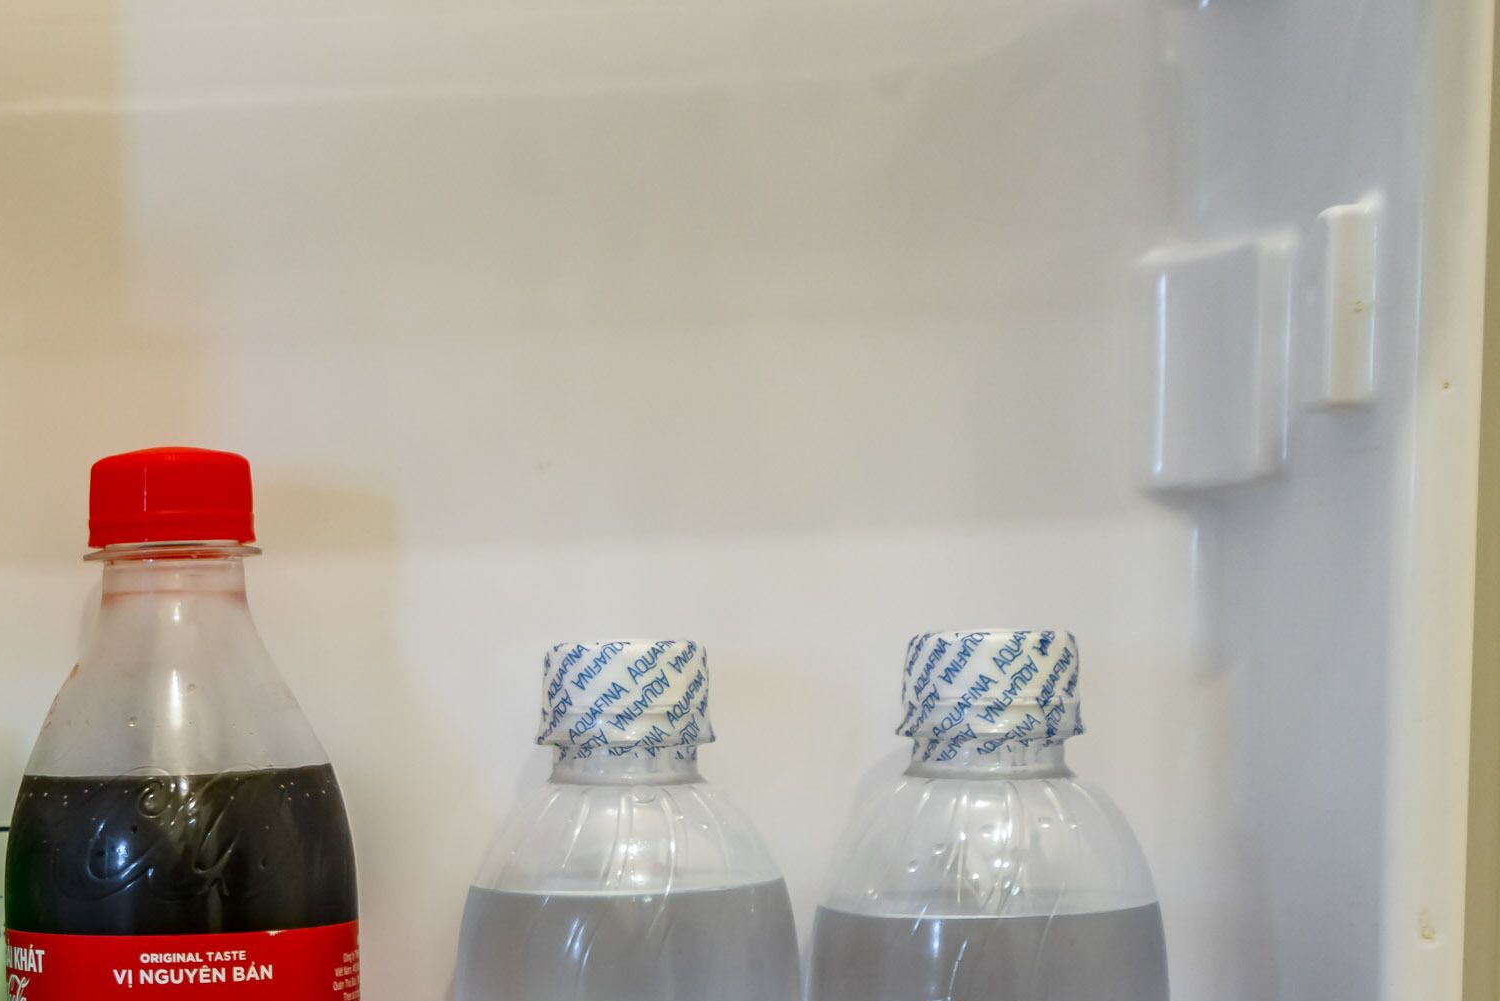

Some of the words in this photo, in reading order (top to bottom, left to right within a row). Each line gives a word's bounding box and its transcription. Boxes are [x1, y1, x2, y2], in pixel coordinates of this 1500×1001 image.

[567, 681, 630, 745] AQUAFINA
[606, 668, 670, 731] AQUAFINA
[933, 674, 998, 737] AQUAFINA
[976, 655, 1038, 724] AQUAFINA
[14, 944, 45, 973] KHÁT
[113, 969, 133, 988] VỊ
[139, 965, 226, 985] NGUYÊN
[233, 962, 273, 982] BẢN
[140, 952, 203, 964] ORIGINAL
[206, 950, 246, 962] TASTE
